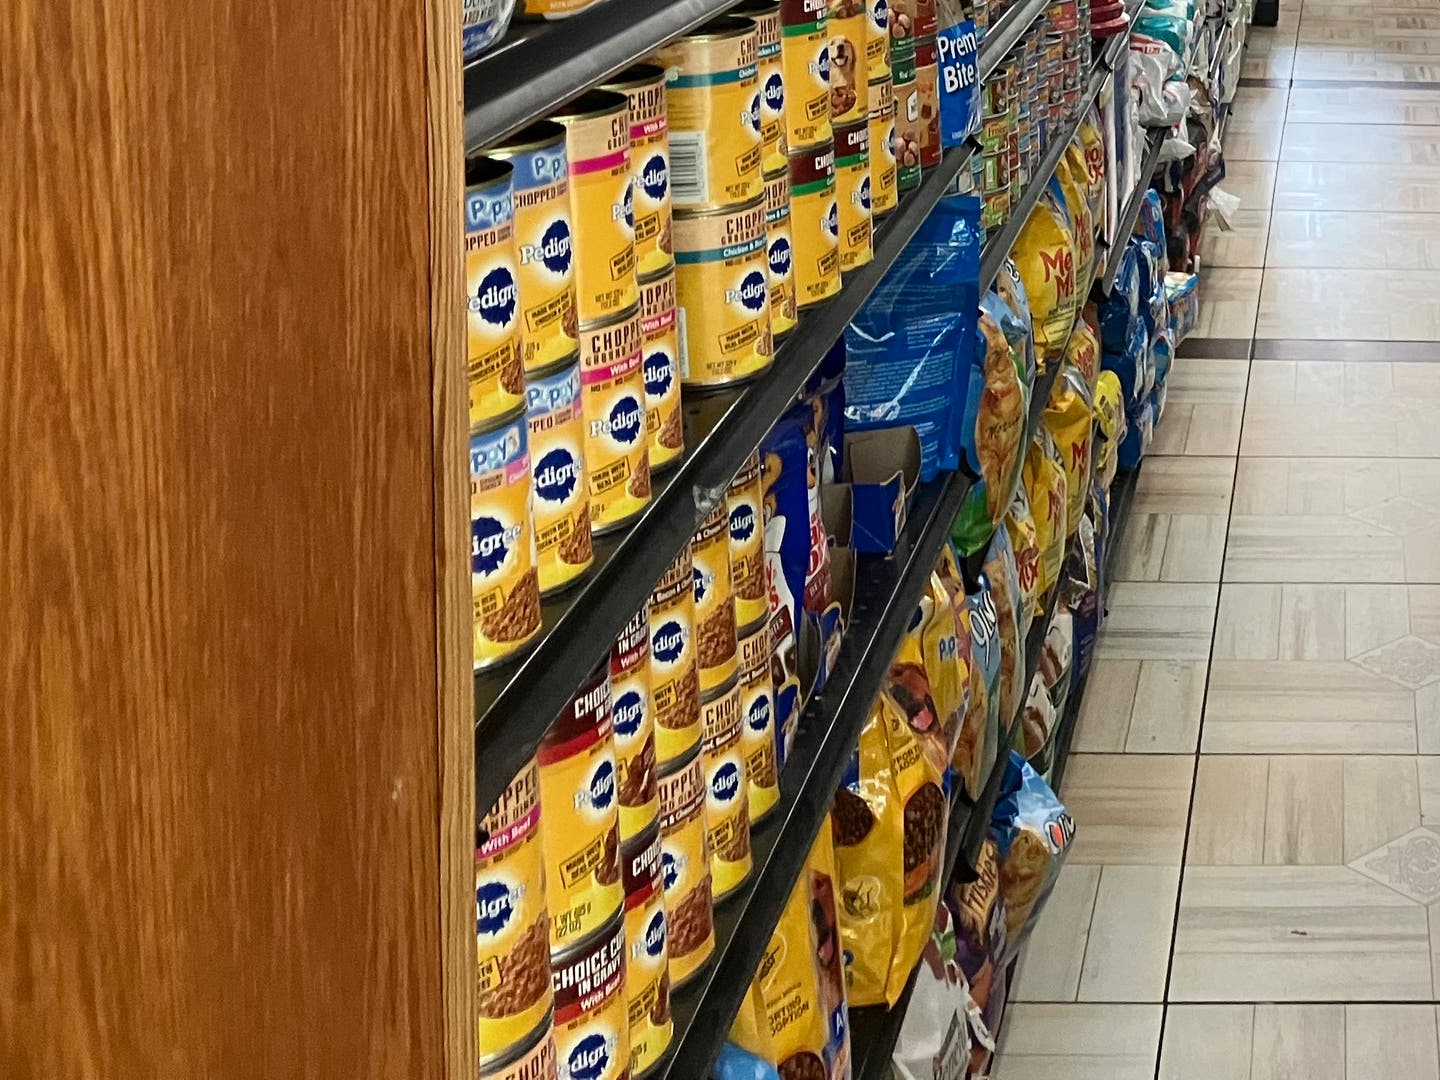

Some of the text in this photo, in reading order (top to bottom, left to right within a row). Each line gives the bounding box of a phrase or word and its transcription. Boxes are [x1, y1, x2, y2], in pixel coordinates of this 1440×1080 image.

[938, 30, 977, 63] Prem
[943, 67, 976, 94] Bite
[520, 236, 572, 265] Pedigr
[466, 284, 517, 312] edigr
[725, 282, 768, 305] Pedigr
[591, 318, 641, 353] CHOPPE
[590, 407, 643, 438] Pedigr
[480, 819, 533, 854] With Beef
[552, 944, 607, 992] CHOICE
[577, 954, 621, 997] IN GRAVY
[580, 992, 604, 1013] With
